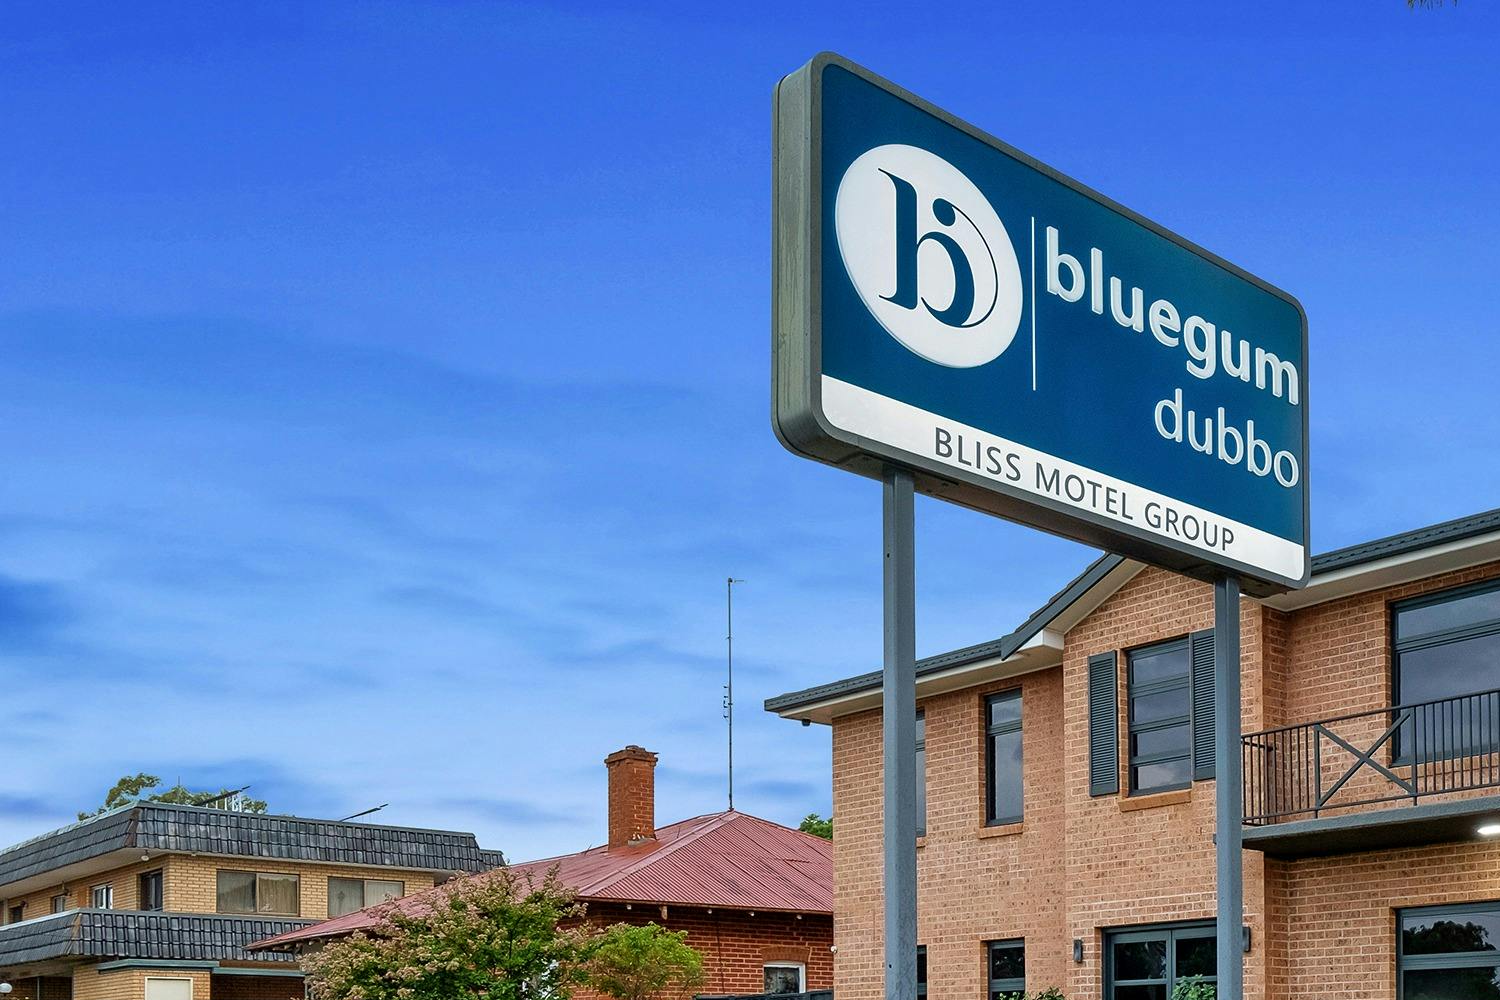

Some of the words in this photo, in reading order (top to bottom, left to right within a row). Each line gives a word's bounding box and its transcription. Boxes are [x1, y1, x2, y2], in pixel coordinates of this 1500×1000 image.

[1046, 225, 1299, 405] bluegum
[934, 427, 1022, 482] BLISS
[1035, 462, 1133, 521] MOTEL
[1144, 502, 1235, 552] GROUP
[1154, 388, 1299, 489] dubbo
